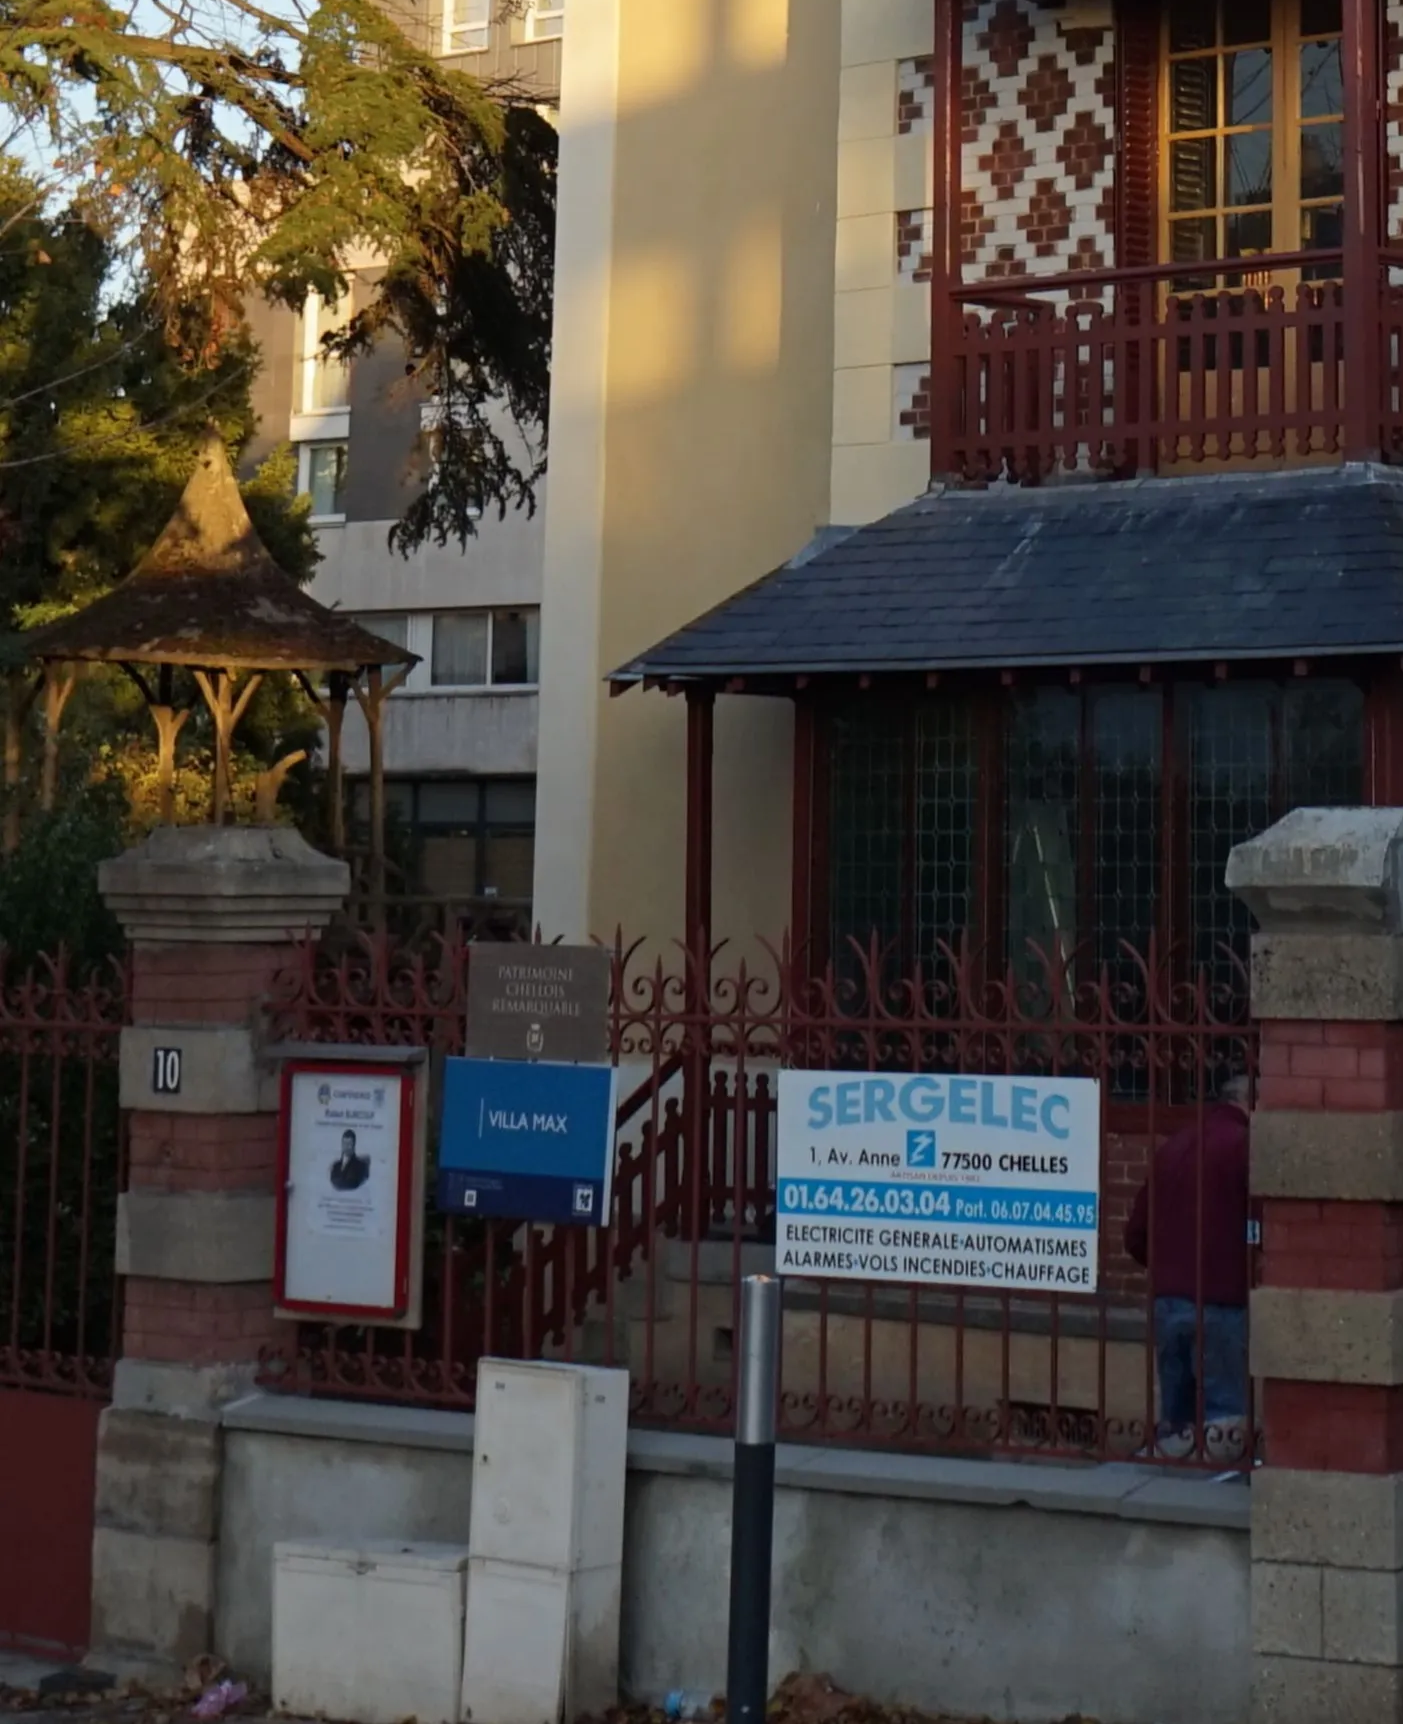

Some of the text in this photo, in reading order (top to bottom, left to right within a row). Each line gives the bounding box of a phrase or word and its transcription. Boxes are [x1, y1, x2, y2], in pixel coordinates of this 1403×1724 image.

[156, 1050, 180, 1090] 10
[488, 1110, 567, 1133] VILLA MAX
[808, 1076, 1070, 1139] SERGELEC
[828, 1147, 852, 1165] Av.
[858, 1149, 900, 1166] Anne
[941, 1152, 992, 1170] 77500
[999, 1154, 1068, 1174] CHELLES
[784, 1184, 951, 1216] 01.64.26.03.04
[991, 1200, 1094, 1224] 06.07.04.45.95
[786, 1224, 874, 1245] ELECTRICITE
[964, 1234, 1087, 1257] AUTOMATISMES
[783, 1250, 1089, 1284] ALARMES VOLS INCENDIES CHAUFFAGE
